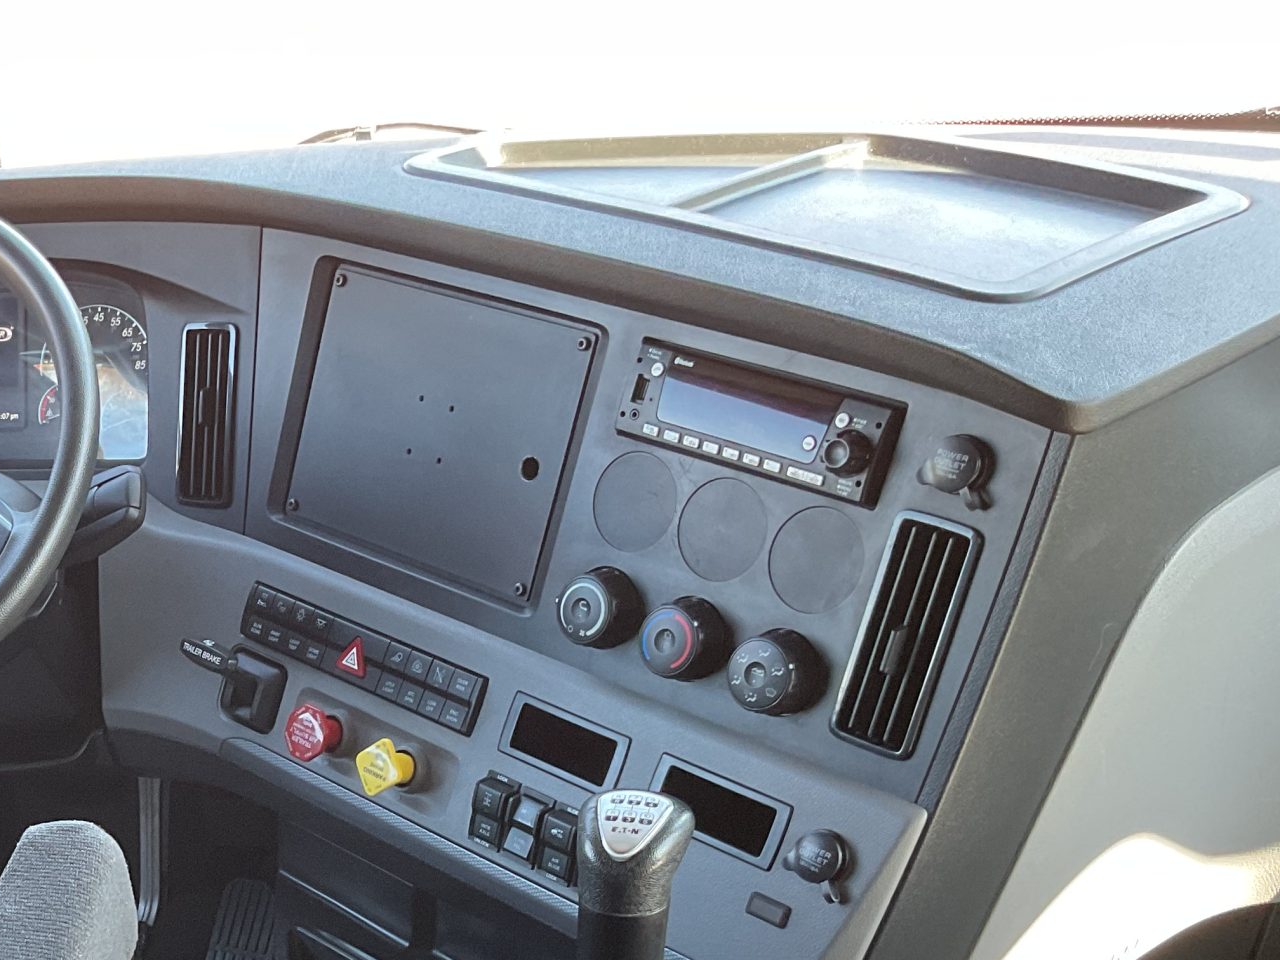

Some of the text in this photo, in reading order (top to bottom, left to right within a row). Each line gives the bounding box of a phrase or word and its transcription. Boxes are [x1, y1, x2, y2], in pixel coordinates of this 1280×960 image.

[93, 312, 105, 322] 45
[110, 317, 121, 327] 55
[122, 327, 133, 338] 65
[131, 342, 142, 352] 75
[134, 360, 146, 370] 85
[936, 448, 969, 462] POWER
[182, 641, 222, 665] TRAILER BRAKE
